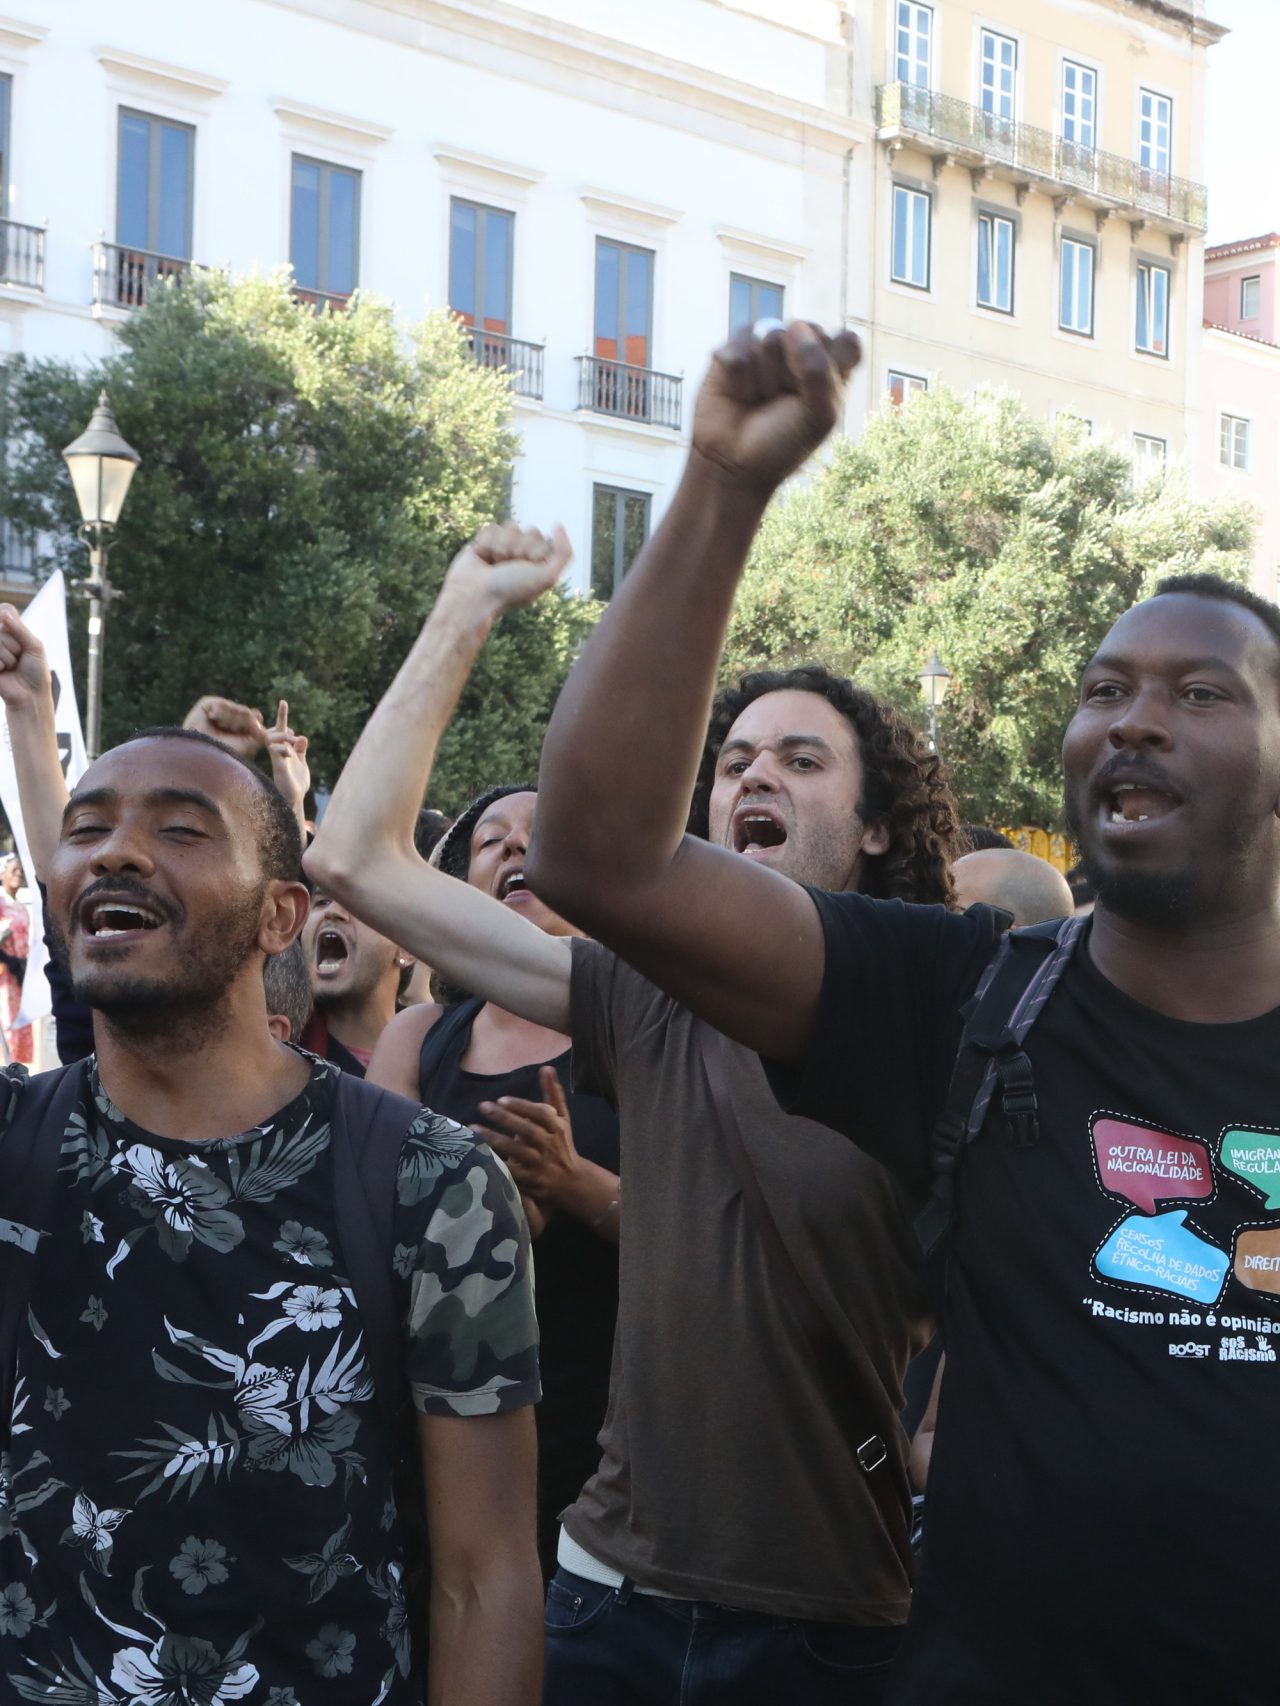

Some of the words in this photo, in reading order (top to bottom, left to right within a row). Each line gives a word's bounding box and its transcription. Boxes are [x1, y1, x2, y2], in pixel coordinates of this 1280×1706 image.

[1108, 1145, 1154, 1162] OUTRA
[1157, 1149, 1178, 1164] LEI
[1181, 1151, 1197, 1166] DA
[1107, 1158, 1204, 1180] NACIONALIDADE
[1120, 1228, 1165, 1251] CENSOS
[1112, 1249, 1199, 1291] ÉTNICO-RACIAIS
[1116, 1237, 1165, 1266] RECOLHA
[1168, 1258, 1182, 1271] DE
[1184, 1263, 1221, 1282] DADOS
[1083, 1297, 1164, 1325] “Racismo
[1169, 1309, 1201, 1326] não
[1206, 1311, 1216, 1326] é
[1168, 1341, 1211, 1356] BOOST
[1221, 1336, 1245, 1349] SOS
